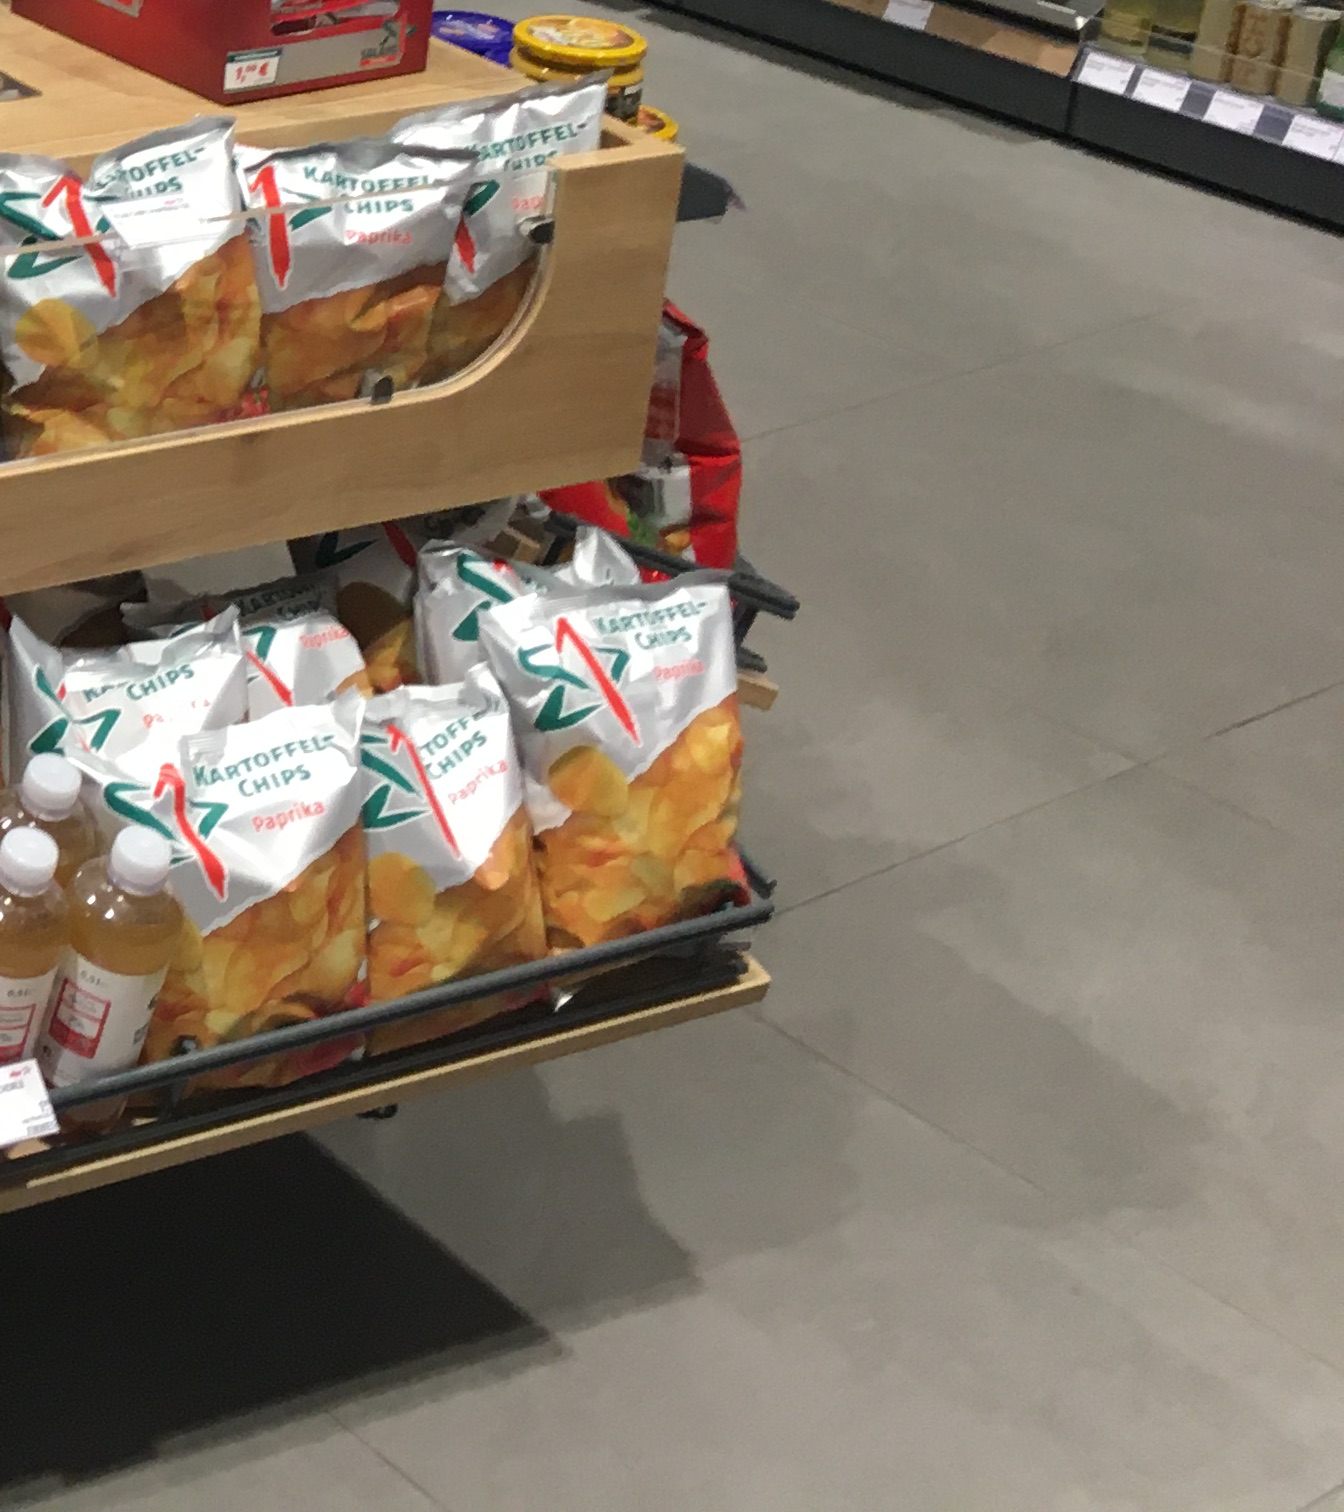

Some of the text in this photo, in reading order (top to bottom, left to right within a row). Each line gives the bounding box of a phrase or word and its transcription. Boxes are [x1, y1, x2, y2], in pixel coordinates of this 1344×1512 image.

[343, 198, 414, 214] CHIPS
[346, 228, 413, 246] Paprika
[594, 600, 707, 635] KARTOFFEL-
[634, 626, 692, 650] CHIPS
[126, 664, 195, 701] CHIPS
[193, 735, 334, 787] KARTOFFEL-
[425, 729, 488, 780] CHIPS
[238, 763, 311, 798] CHIPS
[448, 759, 509, 804] Paprika
[252, 800, 326, 833] Paprika
